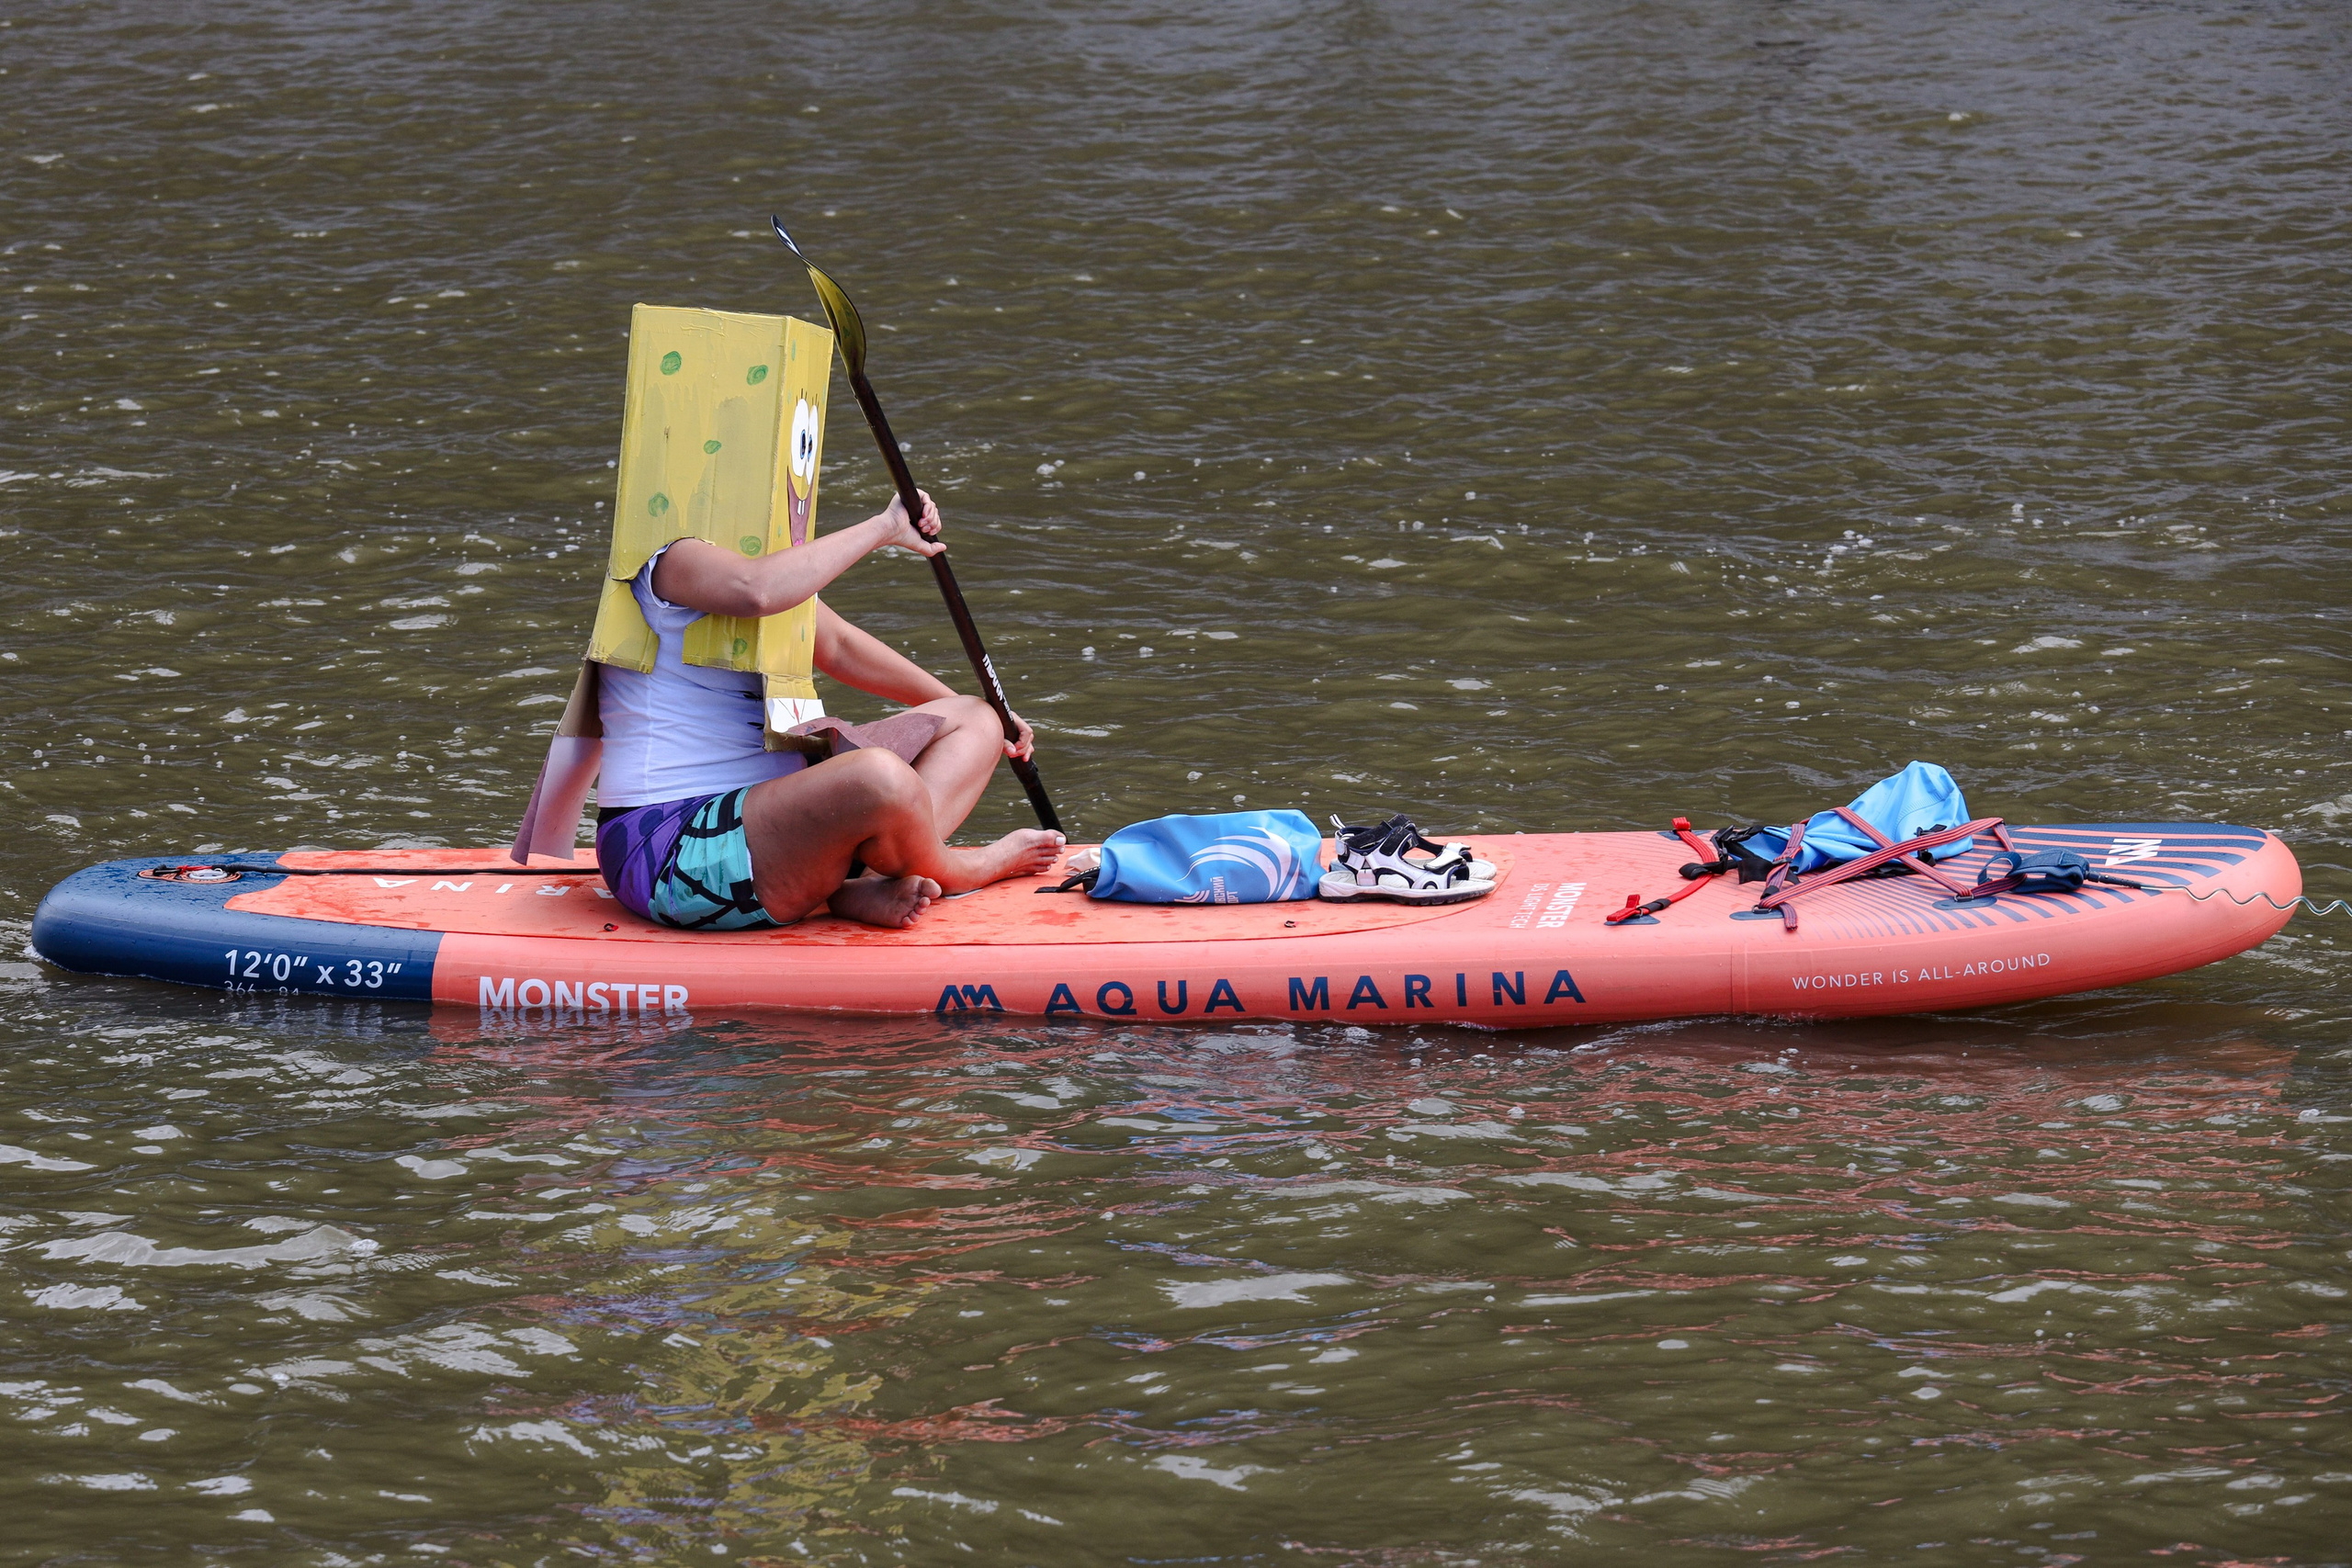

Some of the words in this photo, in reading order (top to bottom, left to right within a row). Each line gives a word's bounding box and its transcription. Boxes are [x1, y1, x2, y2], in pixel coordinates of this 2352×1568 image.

[1210, 875, 1227, 904] ВСКИЙ
[1519, 893, 1544, 910] LIGHT
[1531, 883, 1551, 892] DS
[1509, 911, 1533, 929] TECH
[1536, 882, 1588, 929] MONSTER
[1792, 971, 1883, 990] WONDER
[1893, 969, 1909, 984] IS
[1917, 952, 2051, 982] ALL-AROUND
[479, 976, 689, 1011] MONSTER
[1044, 977, 1246, 1015] AQUA
[1288, 969, 1587, 1011] MARINA
